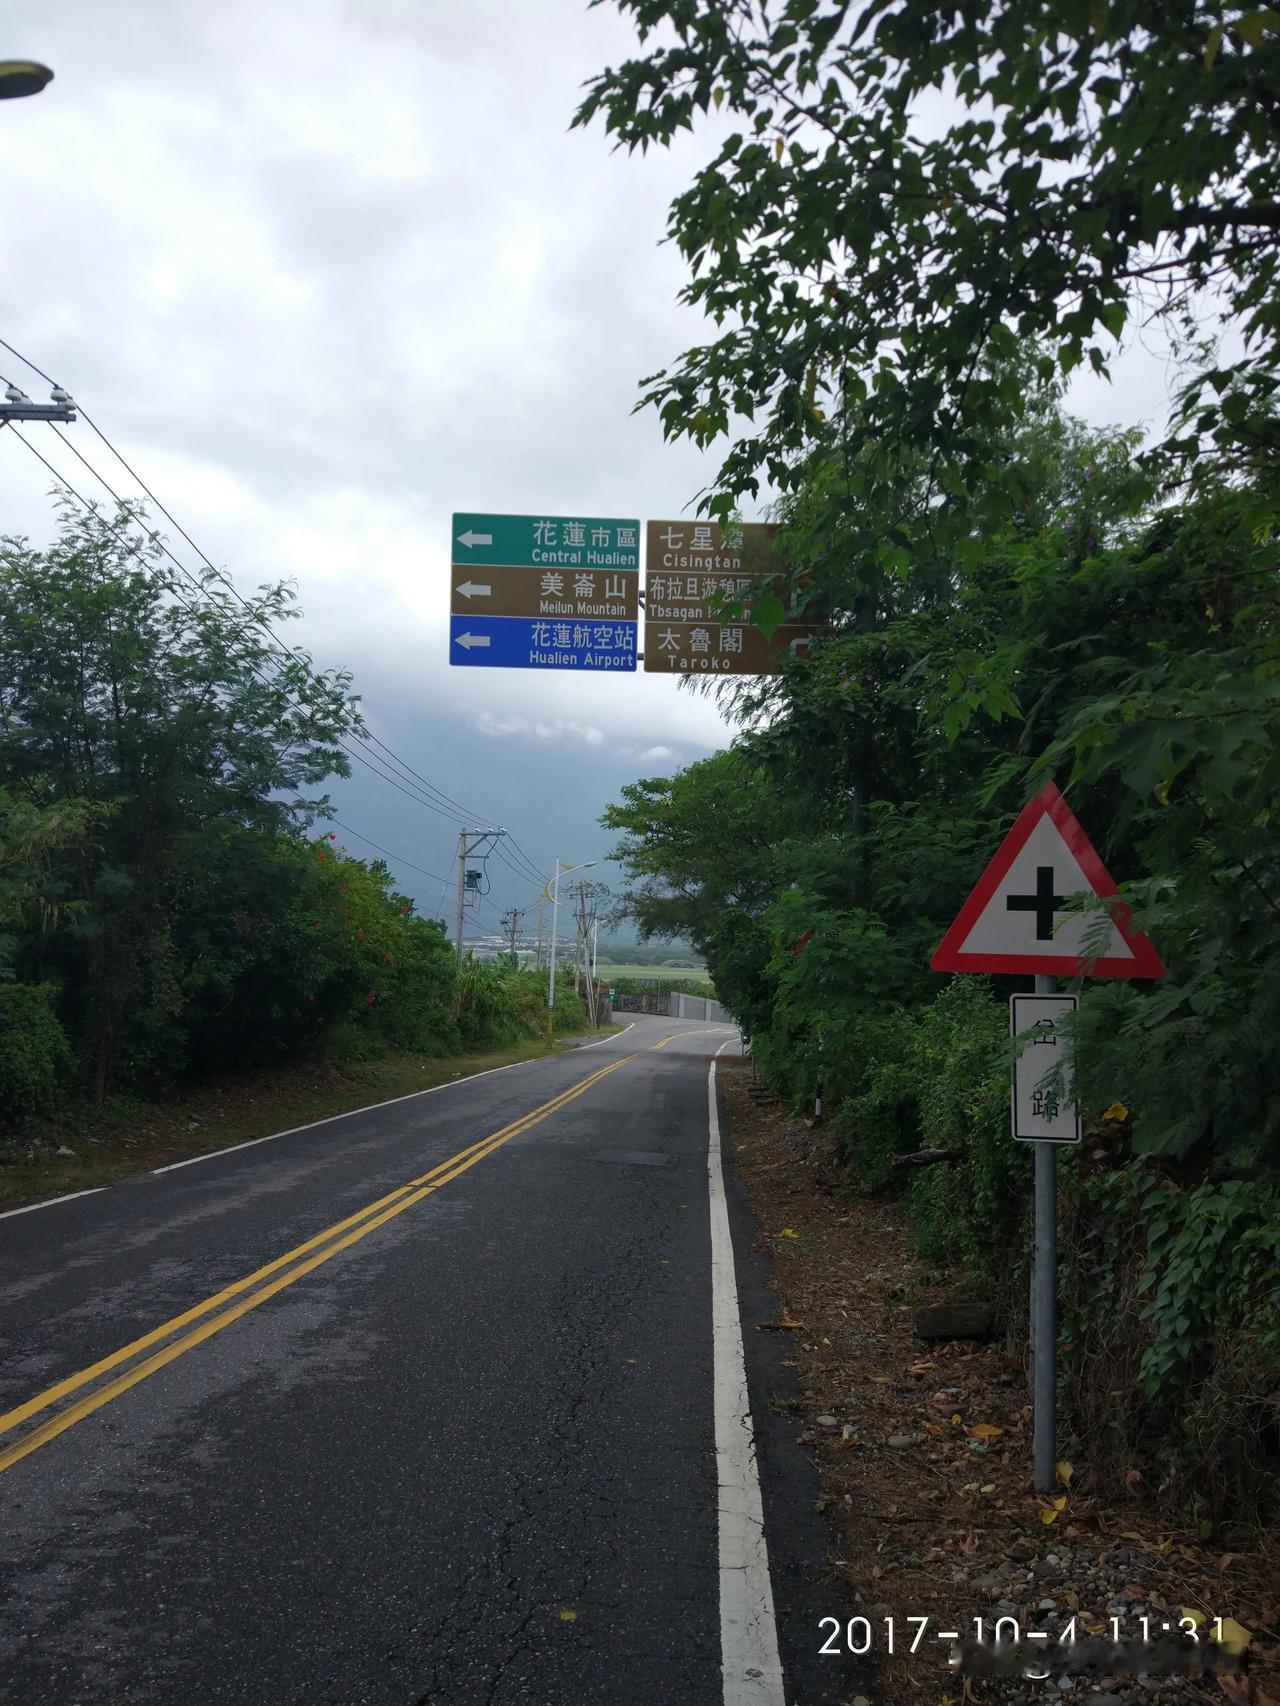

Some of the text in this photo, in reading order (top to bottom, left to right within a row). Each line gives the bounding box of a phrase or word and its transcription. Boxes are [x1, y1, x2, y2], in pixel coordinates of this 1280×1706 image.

[533, 520, 636, 547] 花蓮市區
[532, 549, 636, 565] Central Hualien
[663, 554, 741, 571] Cisingtan
[540, 572, 626, 598] 美崙山
[540, 600, 626, 616] Meilun Mountain
[649, 604, 703, 622] Tbsagan
[531, 622, 634, 650] 花蓮航空站
[658, 628, 743, 653] 太魯閣
[530, 650, 633, 669] Hualien Airport
[668, 656, 731, 669] Taroko
